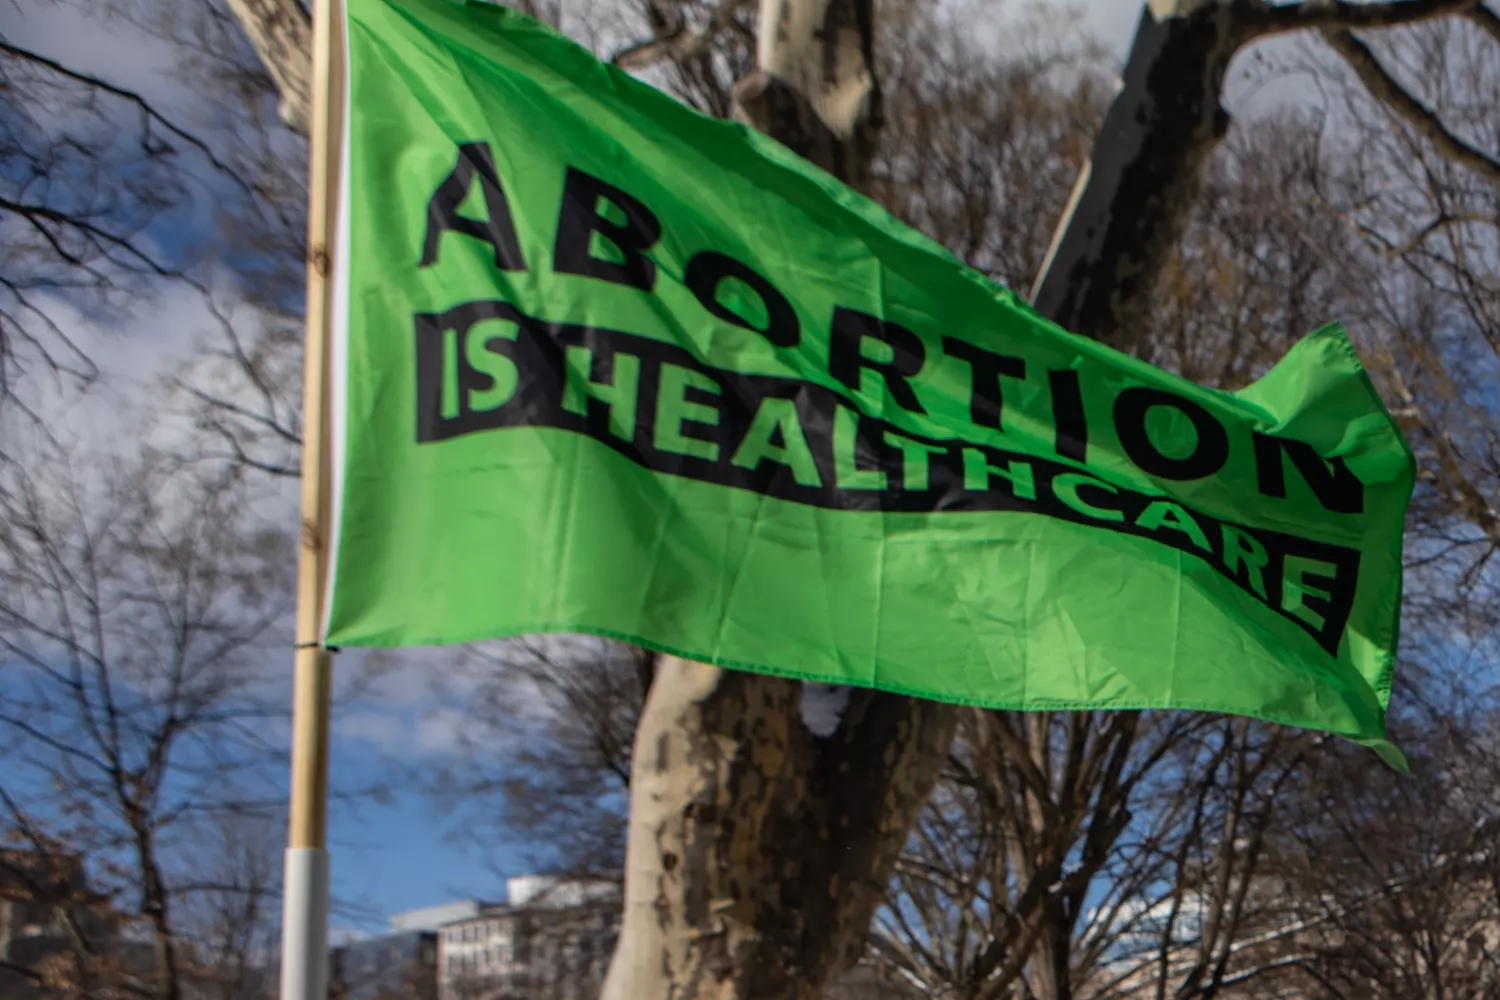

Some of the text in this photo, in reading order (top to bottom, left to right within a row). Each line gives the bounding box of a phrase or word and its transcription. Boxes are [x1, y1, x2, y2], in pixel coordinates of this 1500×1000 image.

[418, 141, 1366, 514] ABORTION
[439, 317, 1339, 633] IS HEALTHCARE
